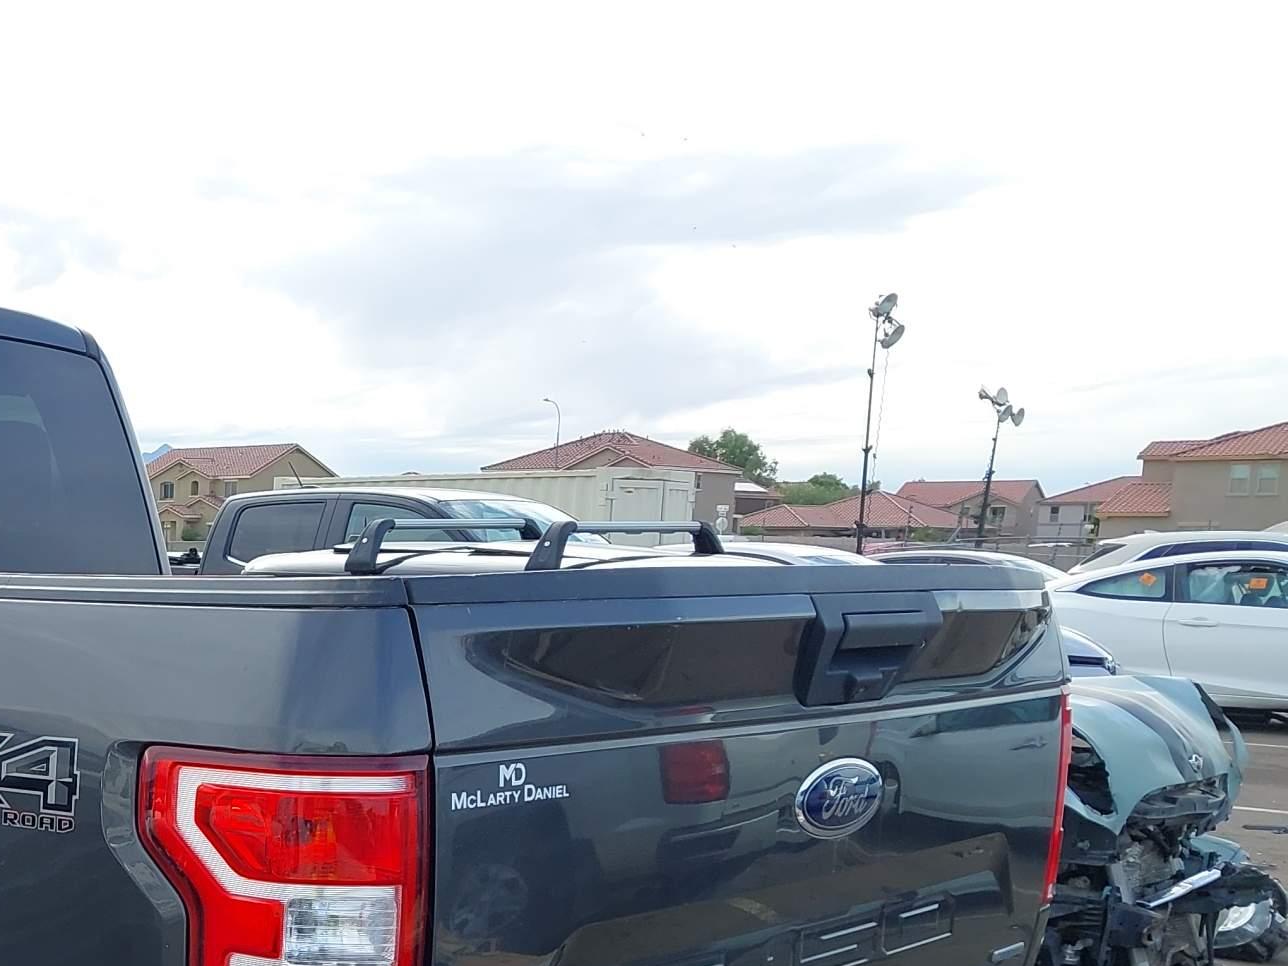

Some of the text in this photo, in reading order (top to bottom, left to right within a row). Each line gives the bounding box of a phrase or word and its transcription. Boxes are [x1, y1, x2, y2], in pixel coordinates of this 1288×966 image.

[498, 762, 527, 788] MD
[523, 784, 570, 802] DANIEL
[822, 776, 868, 820] Ford
[1, 808, 75, 833] ROAD
